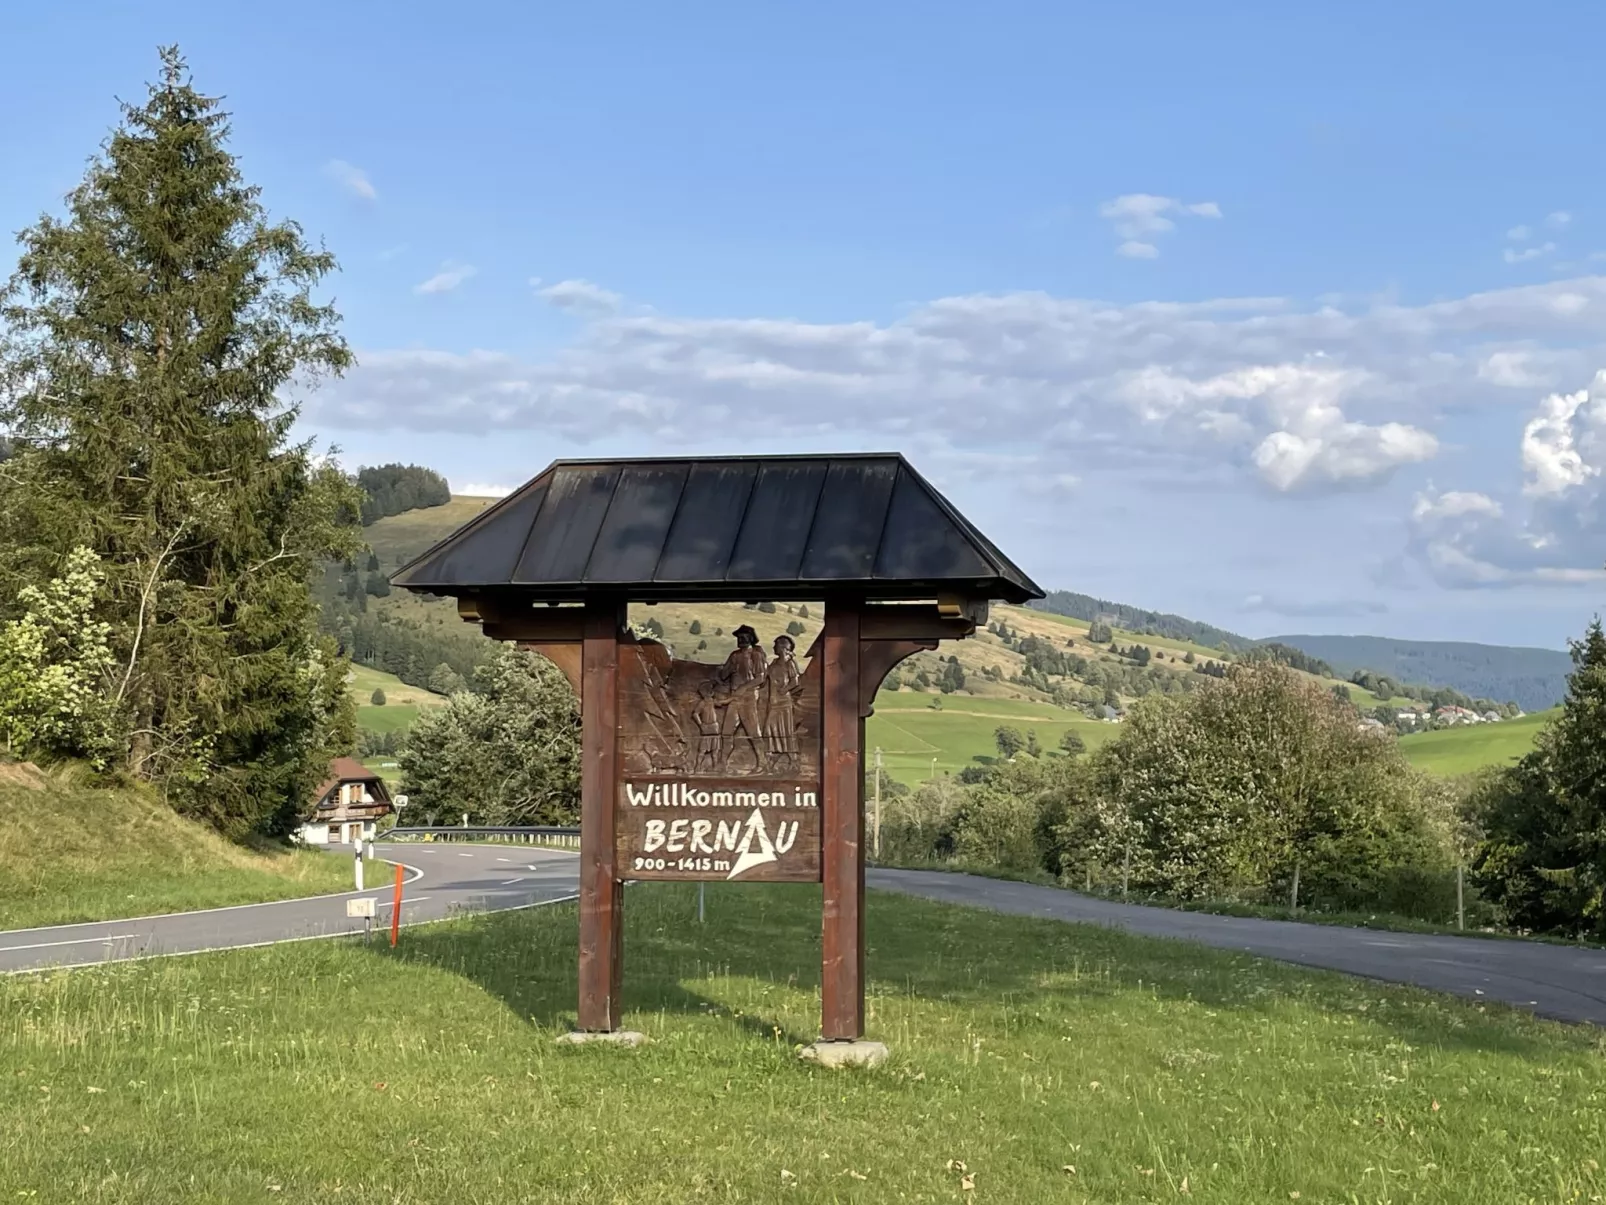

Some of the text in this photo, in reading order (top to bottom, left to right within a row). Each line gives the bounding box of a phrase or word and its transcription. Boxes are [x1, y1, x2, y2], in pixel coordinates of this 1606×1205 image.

[626, 783, 817, 807] Willkommen in
[644, 807, 799, 880] BERNAU
